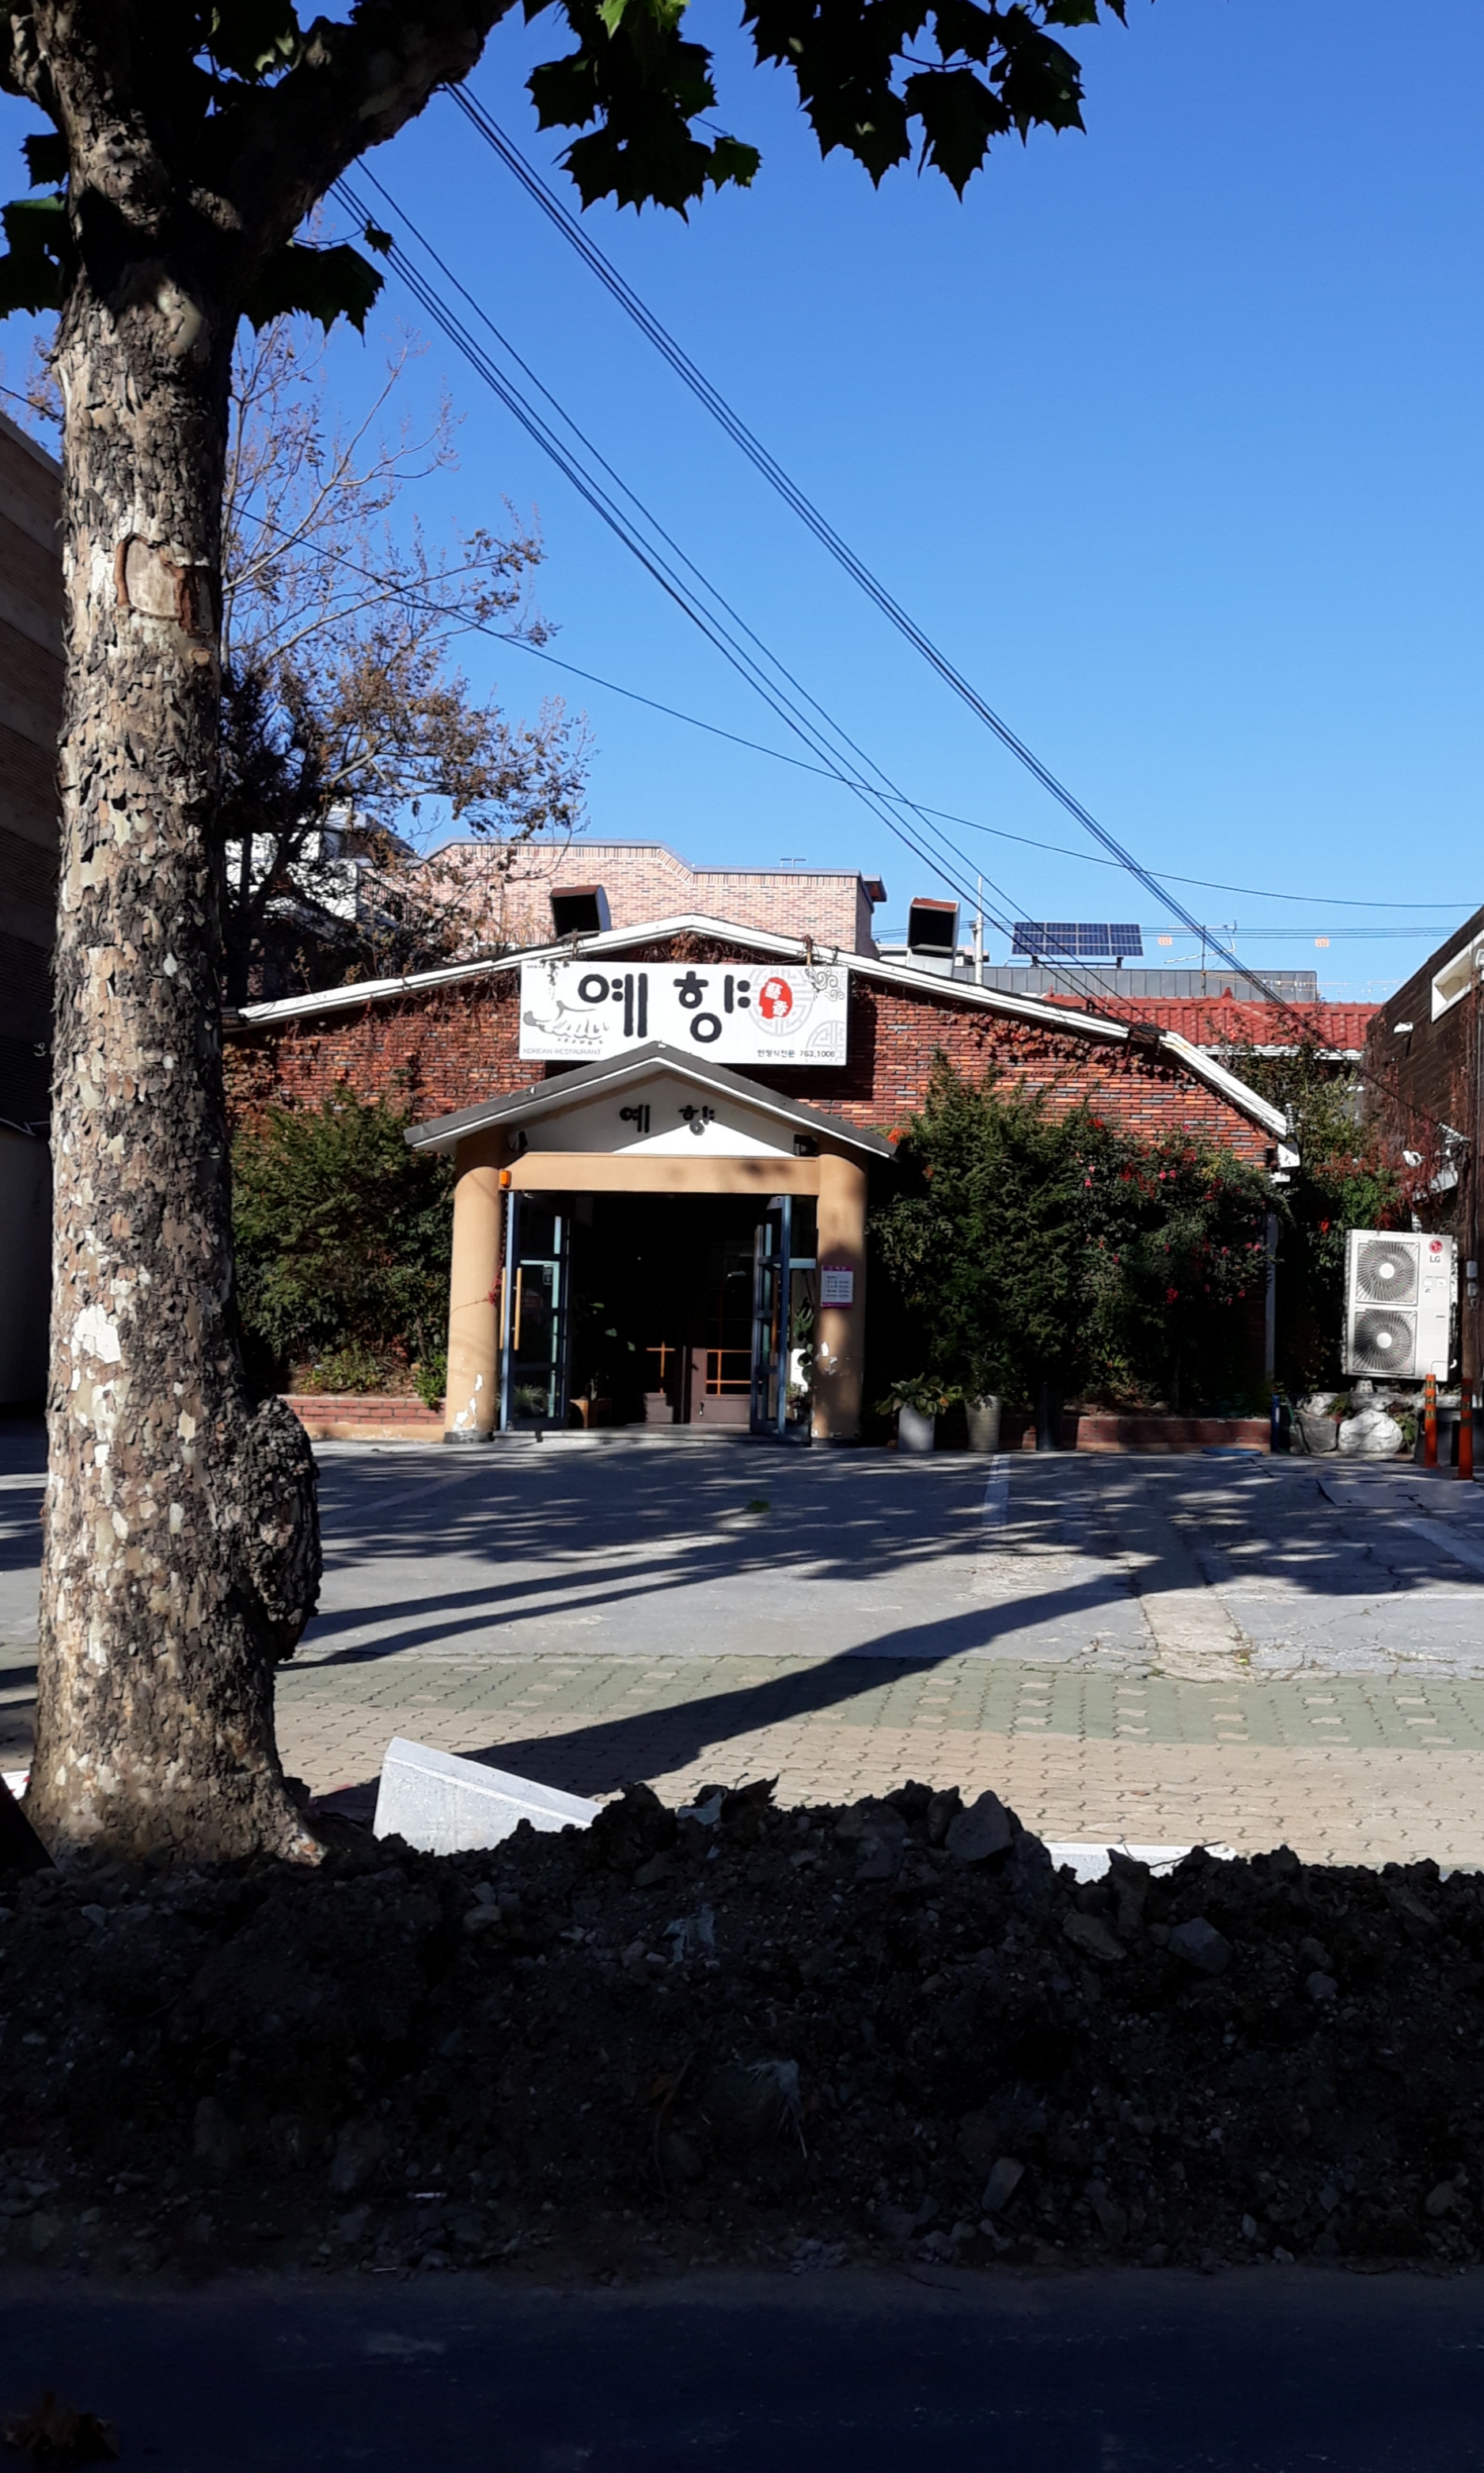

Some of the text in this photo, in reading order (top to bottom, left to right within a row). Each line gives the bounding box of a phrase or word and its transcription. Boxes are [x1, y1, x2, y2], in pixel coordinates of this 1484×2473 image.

[578, 971, 750, 1043] 예향
[619, 1104, 715, 1136] 예향
[1429, 1255, 1441, 1263] LG
